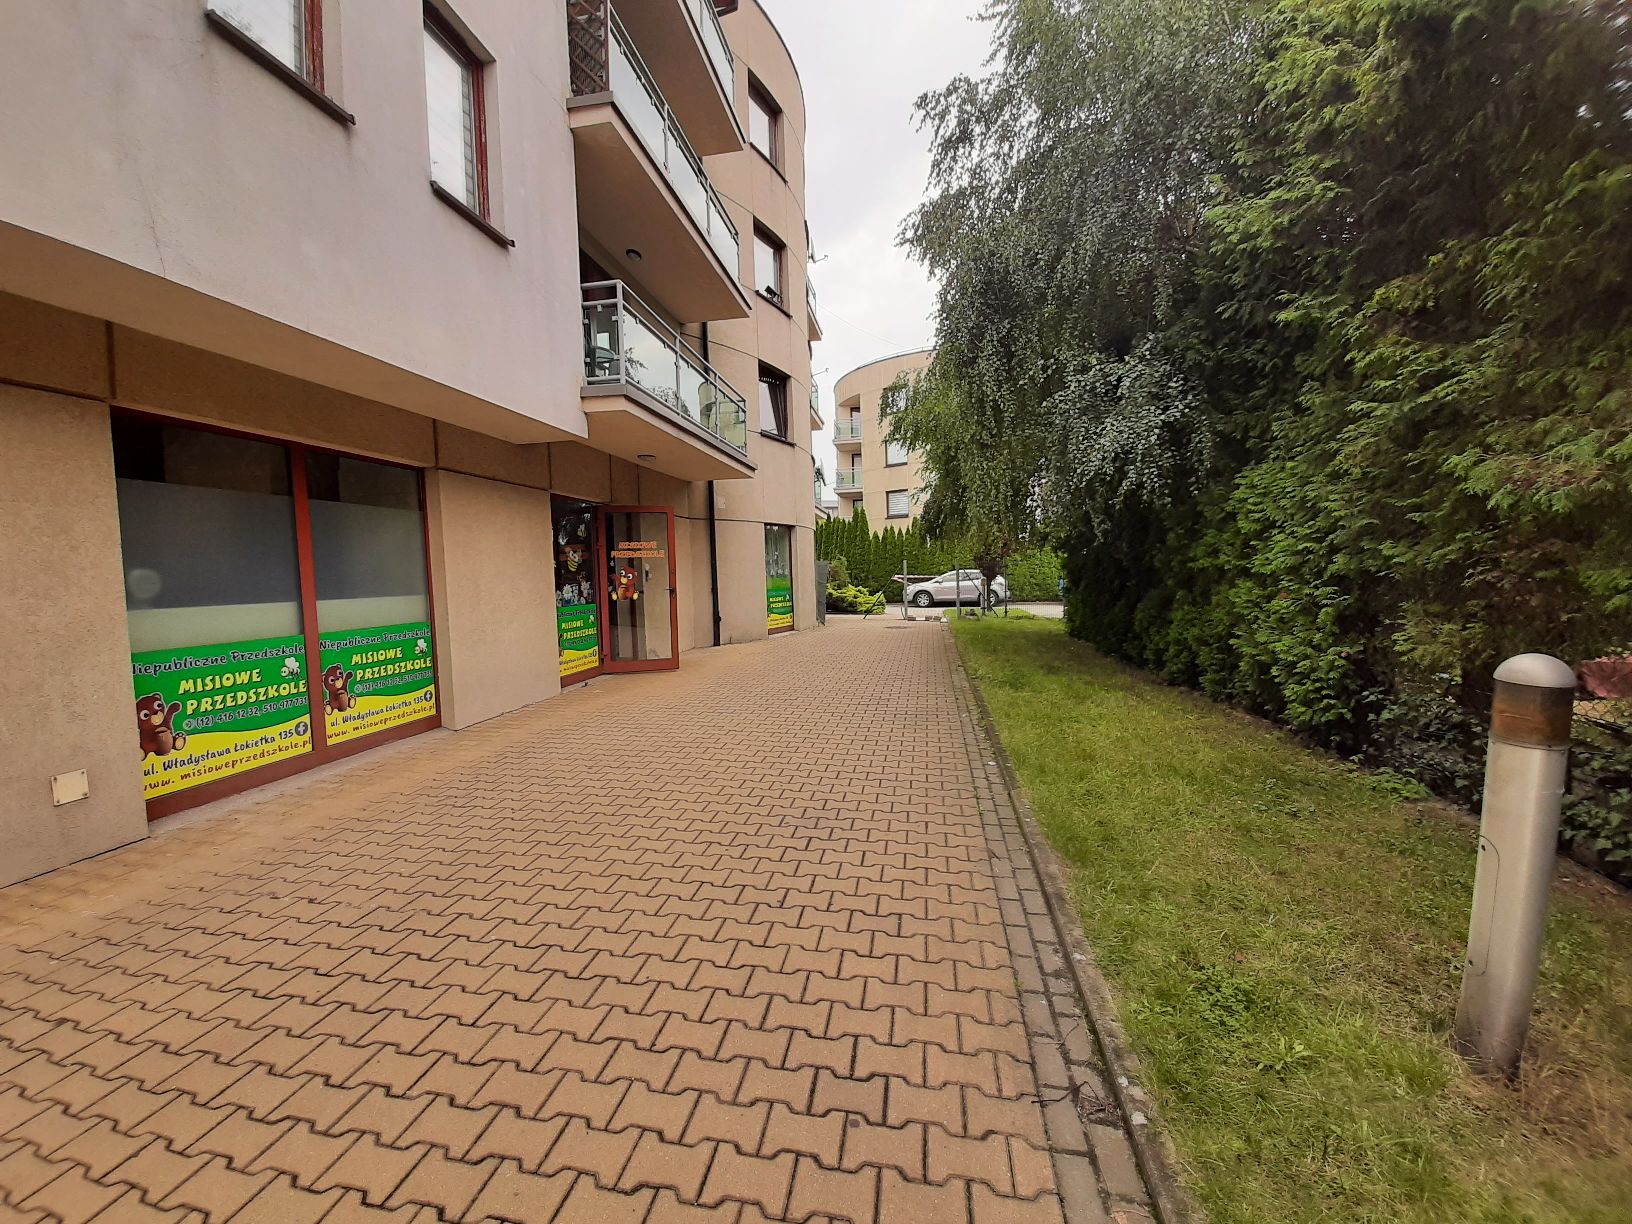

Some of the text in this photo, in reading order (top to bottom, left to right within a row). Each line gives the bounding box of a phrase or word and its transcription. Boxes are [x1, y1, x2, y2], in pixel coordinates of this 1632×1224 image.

[230, 643, 305, 662] Przedszkole
[320, 628, 431, 651] Niepubliczne Przedszkole
[351, 647, 403, 666] MISIOWE
[356, 657, 432, 682] PRZEDSZKOLE
[178, 668, 262, 695] MISIOWE
[186, 680, 307, 716] PRZEDSZKOLE
[196, 715, 214, 729] (12)
[216, 712, 234, 724] 416
[236, 709, 246, 719] 12
[263, 702, 278, 713] 510
[143, 763, 159, 777] ul.
[162, 747, 231, 772] Władysława
[233, 733, 276, 753] Łokietka
[278, 728, 294, 741] 135
[180, 738, 312, 781] misioweprzedszkole.pl
